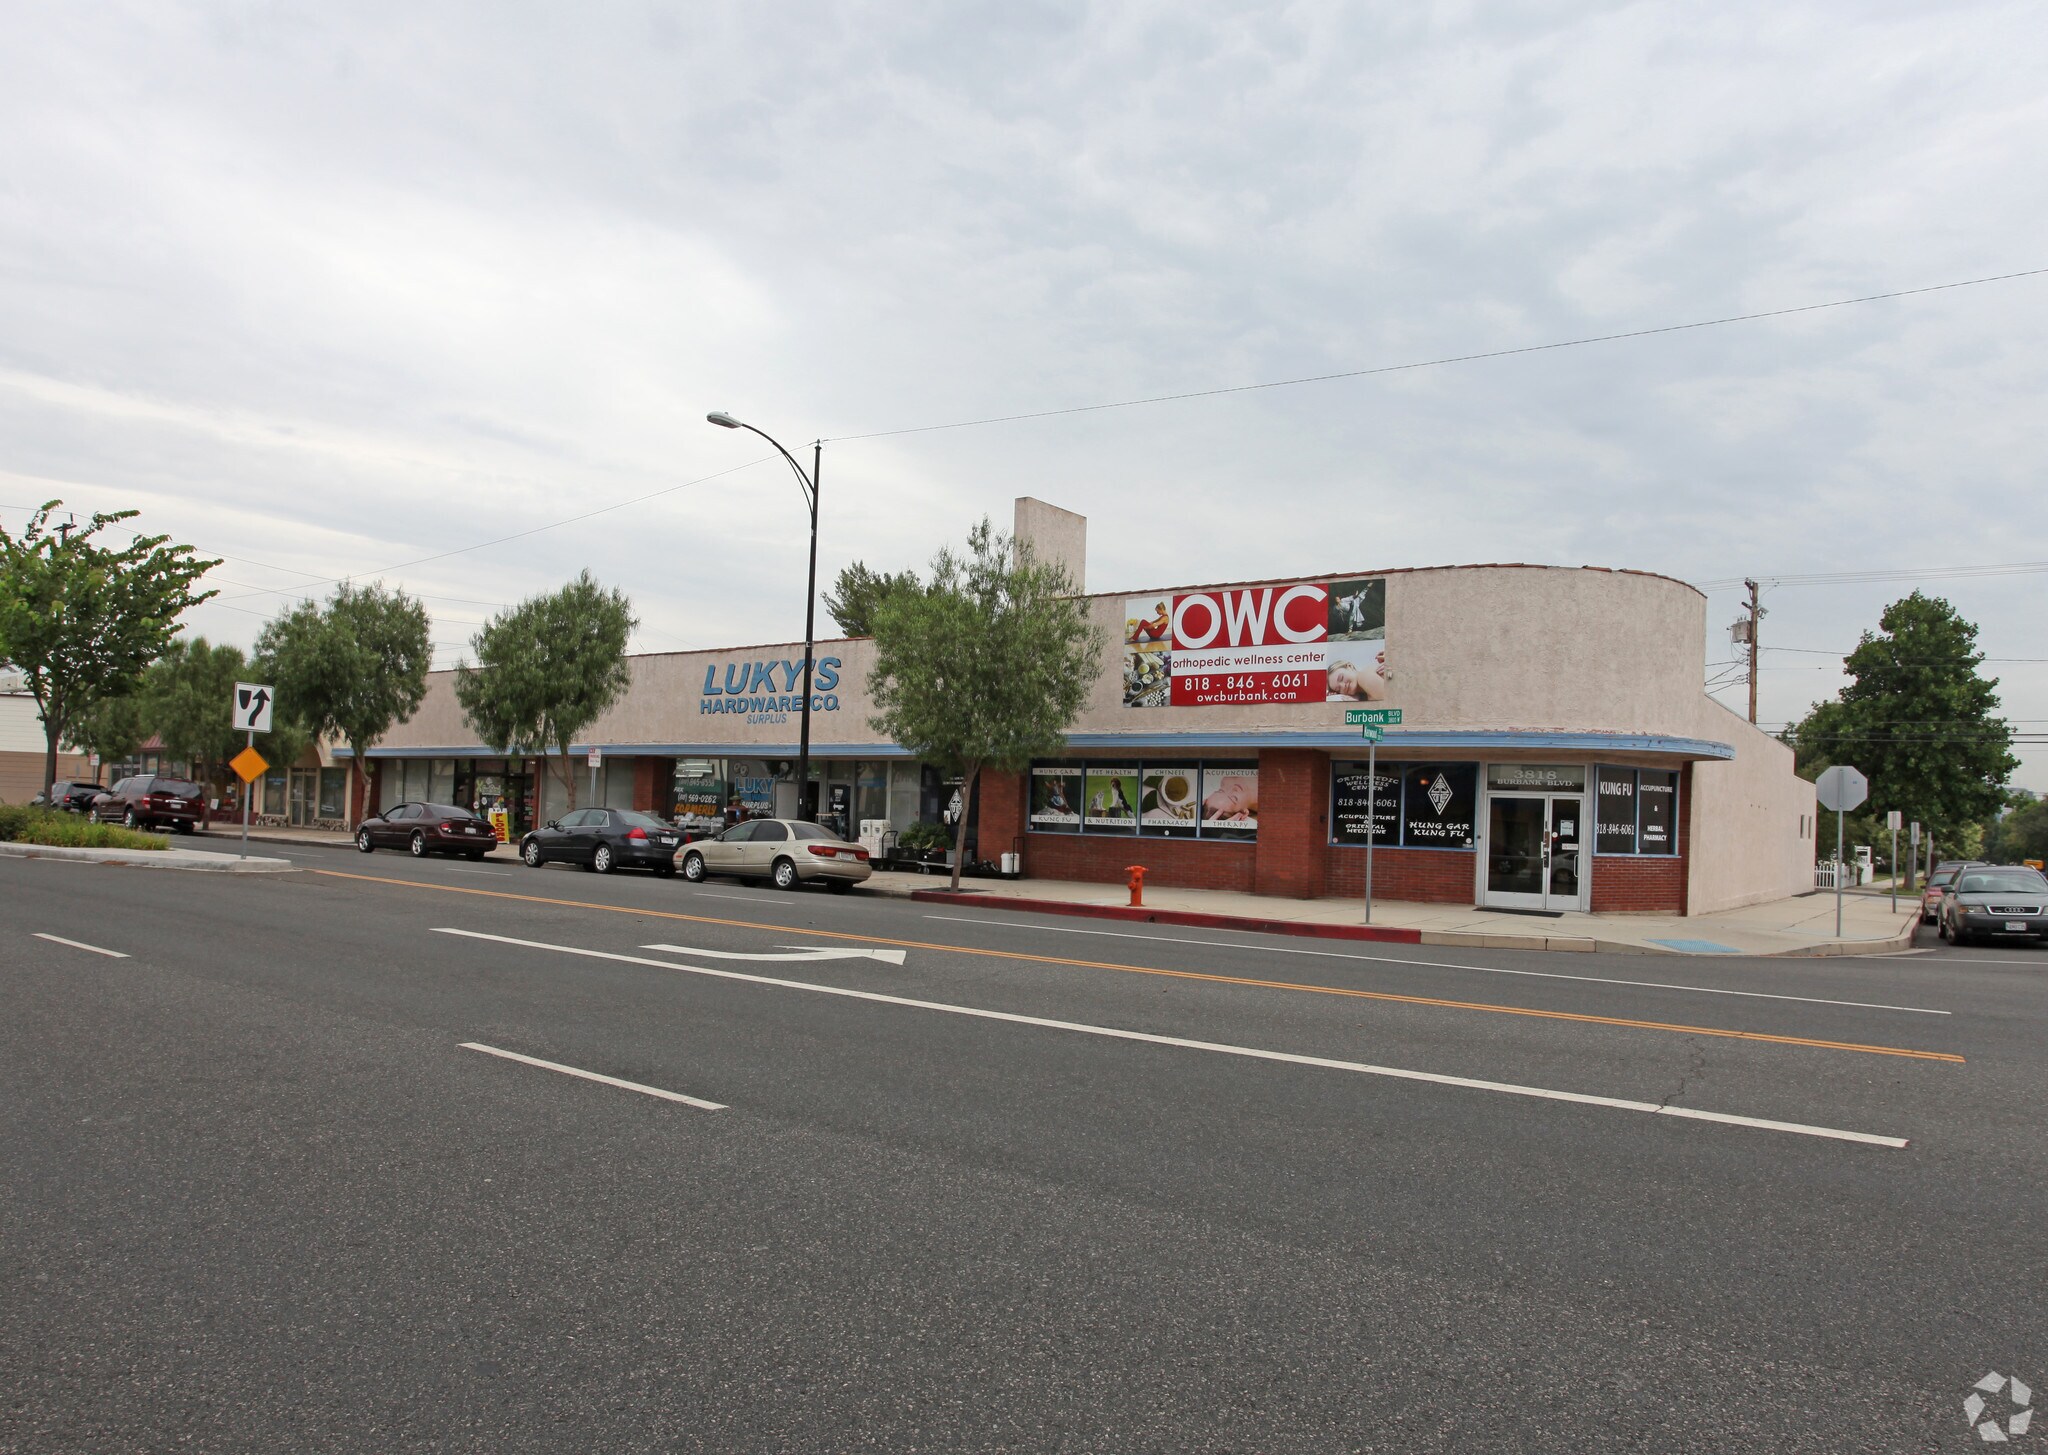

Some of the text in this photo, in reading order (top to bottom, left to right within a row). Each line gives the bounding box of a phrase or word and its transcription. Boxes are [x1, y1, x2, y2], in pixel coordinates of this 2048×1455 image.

[1173, 585, 1327, 649] OWC
[1173, 652, 1325, 669] orthopedic wellness center
[703, 656, 842, 695] LUKY'S
[1185, 677, 1210, 691] 818
[1227, 675, 1254, 689] 846
[1272, 673, 1308, 688] 6061
[1197, 689, 1297, 702] owcburbank.com
[700, 695, 804, 714] HARDWARE
[746, 713, 787, 725] SURPLUS
[1346, 712, 1384, 723] Burbank
[1336, 775, 1399, 784] ORTHOEDIC
[1514, 770, 1557, 780] 3818
[1600, 781, 1632, 796] KUNG FU
[1640, 784, 1672, 793] ACCUPUNCTURE
[674, 803, 718, 816] FORMERLY
[1409, 821, 1442, 829] HUNG
